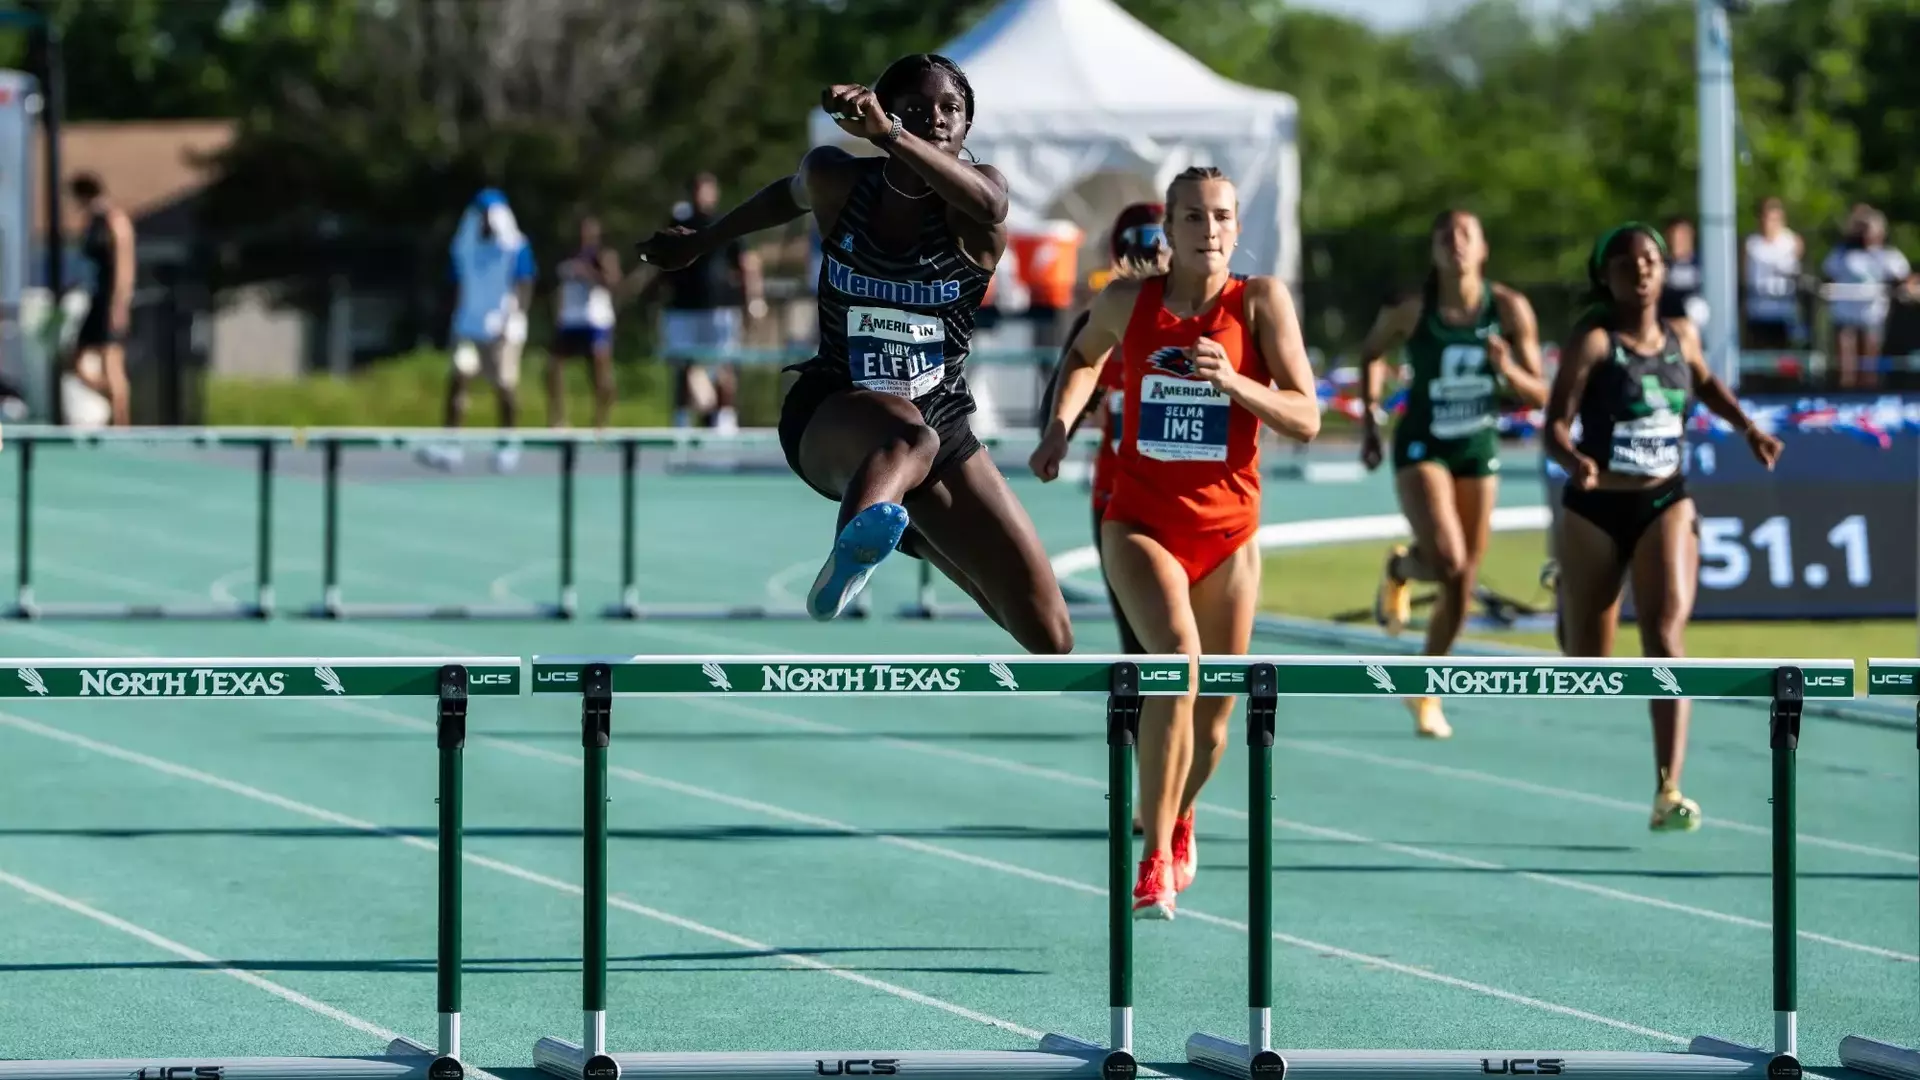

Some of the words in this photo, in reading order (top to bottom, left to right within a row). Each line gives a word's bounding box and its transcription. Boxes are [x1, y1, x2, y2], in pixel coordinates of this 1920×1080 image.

[827, 254, 960, 305] Memphis
[863, 351, 933, 378] ELFUL
[1150, 381, 1221, 399] AMERICAN
[1165, 405, 1204, 418] SELMA
[1163, 417, 1205, 441] IMS
[79, 669, 187, 695] NORTH
[191, 669, 286, 696] TEXAS
[470, 674, 512, 685] UCS
[537, 671, 579, 682] UCS
[761, 665, 866, 691] NORTH
[869, 665, 961, 691] TEXAS
[1140, 670, 1182, 681] UCS
[1204, 672, 1245, 683] UCS
[1425, 668, 1529, 694] NORTH
[1532, 668, 1624, 695] TEXAS
[1804, 676, 1847, 686] UCS
[1871, 674, 1913, 684] UCS
[817, 1059, 898, 1076] UCS
[1481, 1058, 1563, 1075] UCS
